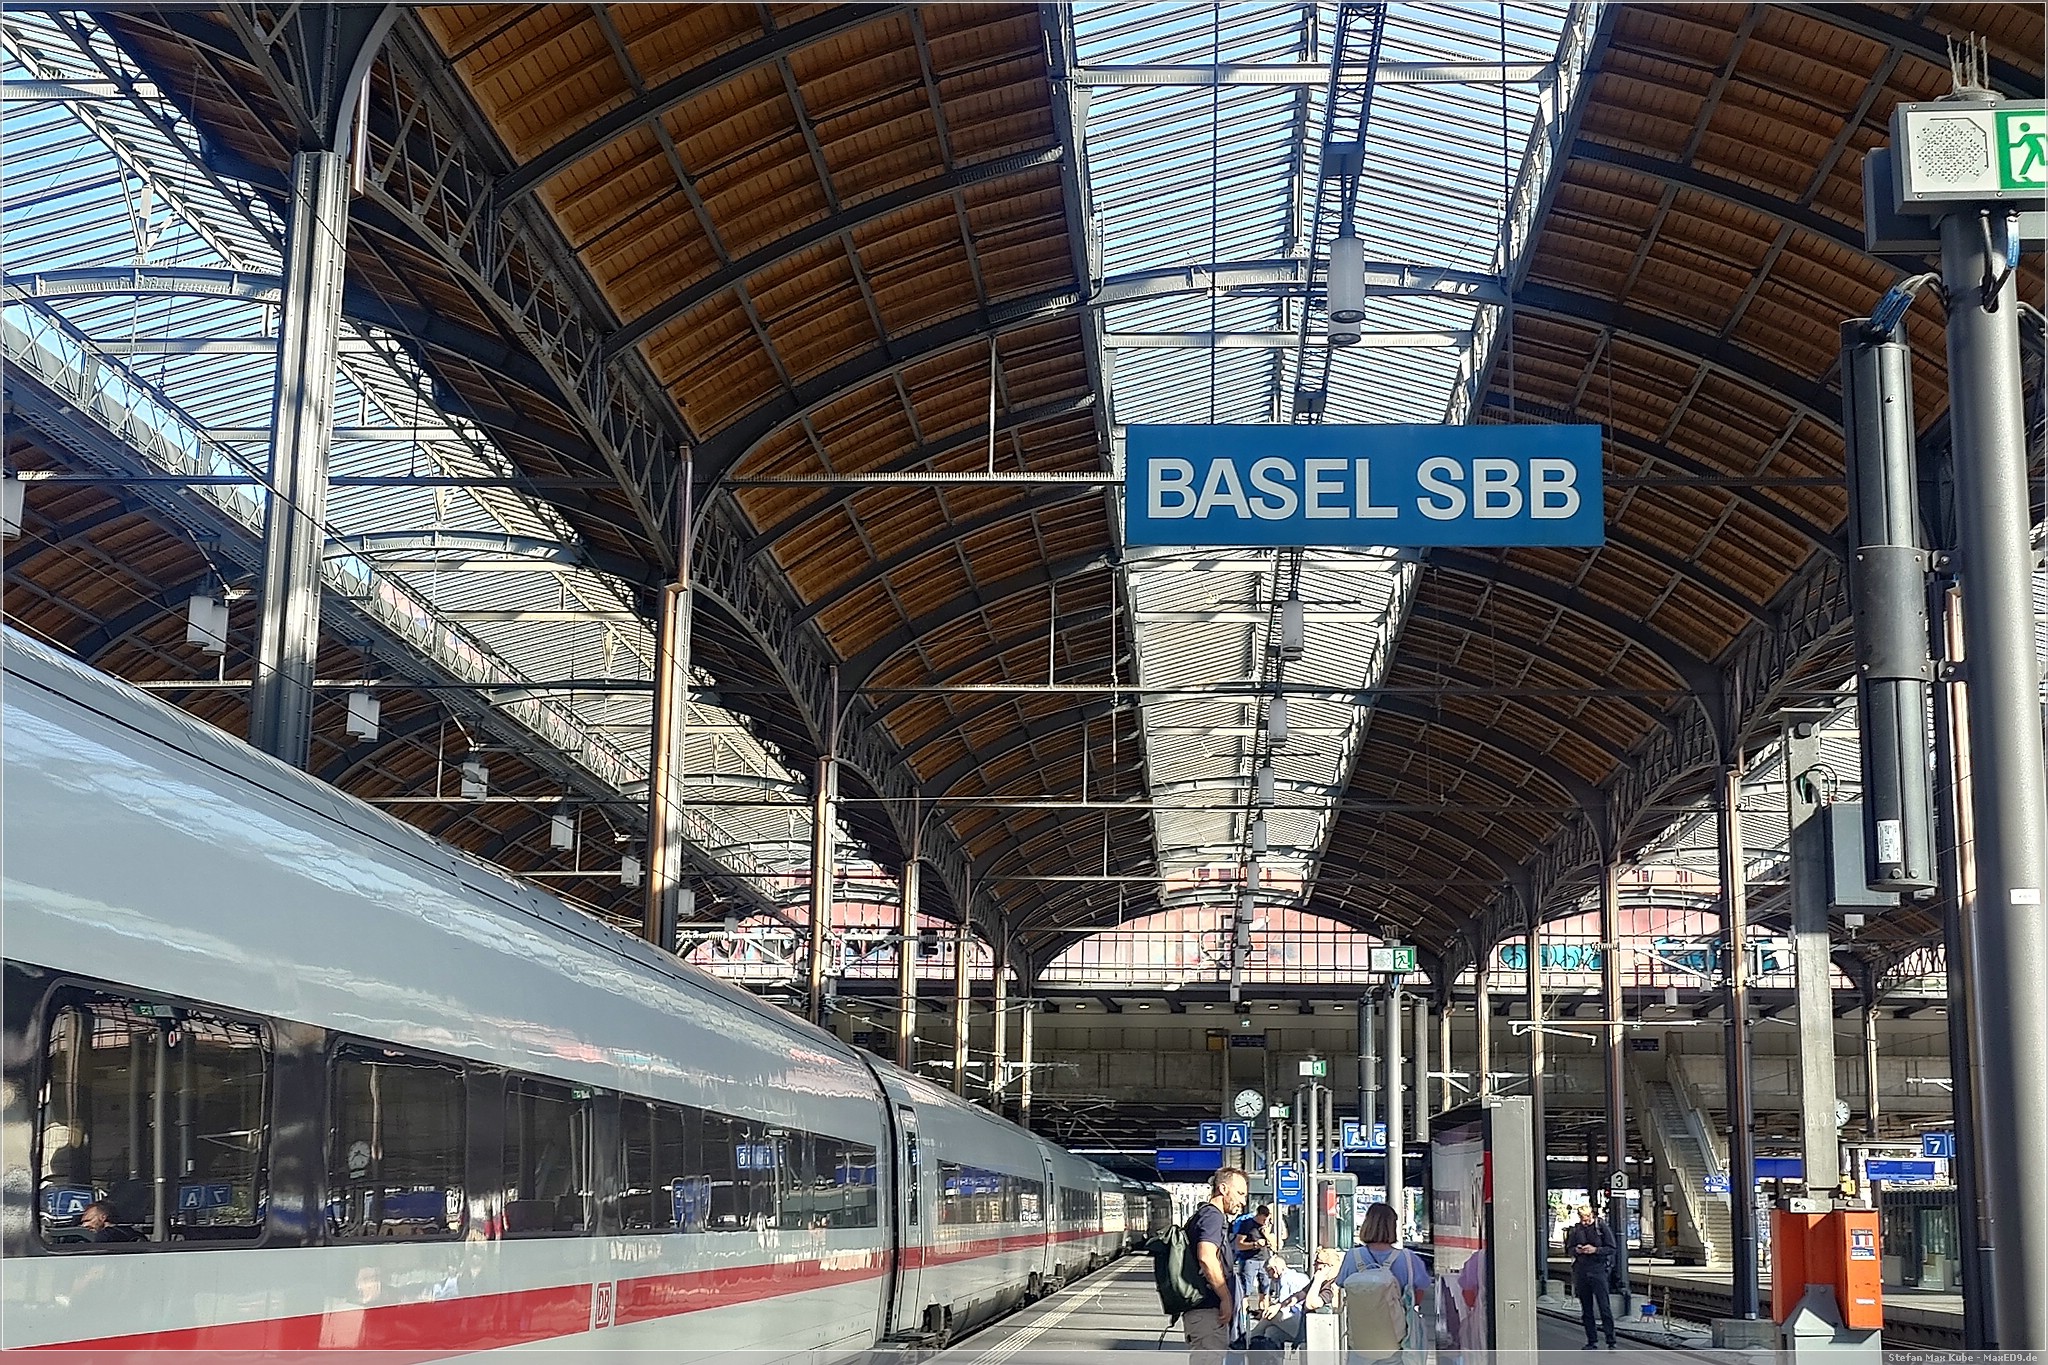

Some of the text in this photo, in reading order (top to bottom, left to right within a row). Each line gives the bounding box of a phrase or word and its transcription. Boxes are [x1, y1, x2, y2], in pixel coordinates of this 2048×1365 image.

[1147, 457, 1581, 520] BASEL SBB
[1206, 1129, 1242, 1143] 5 A
[1375, 1131, 1386, 1146] 6
[1929, 1140, 1941, 1154] 7
[1615, 1174, 1624, 1188] 3
[598, 1289, 610, 1321] DB
